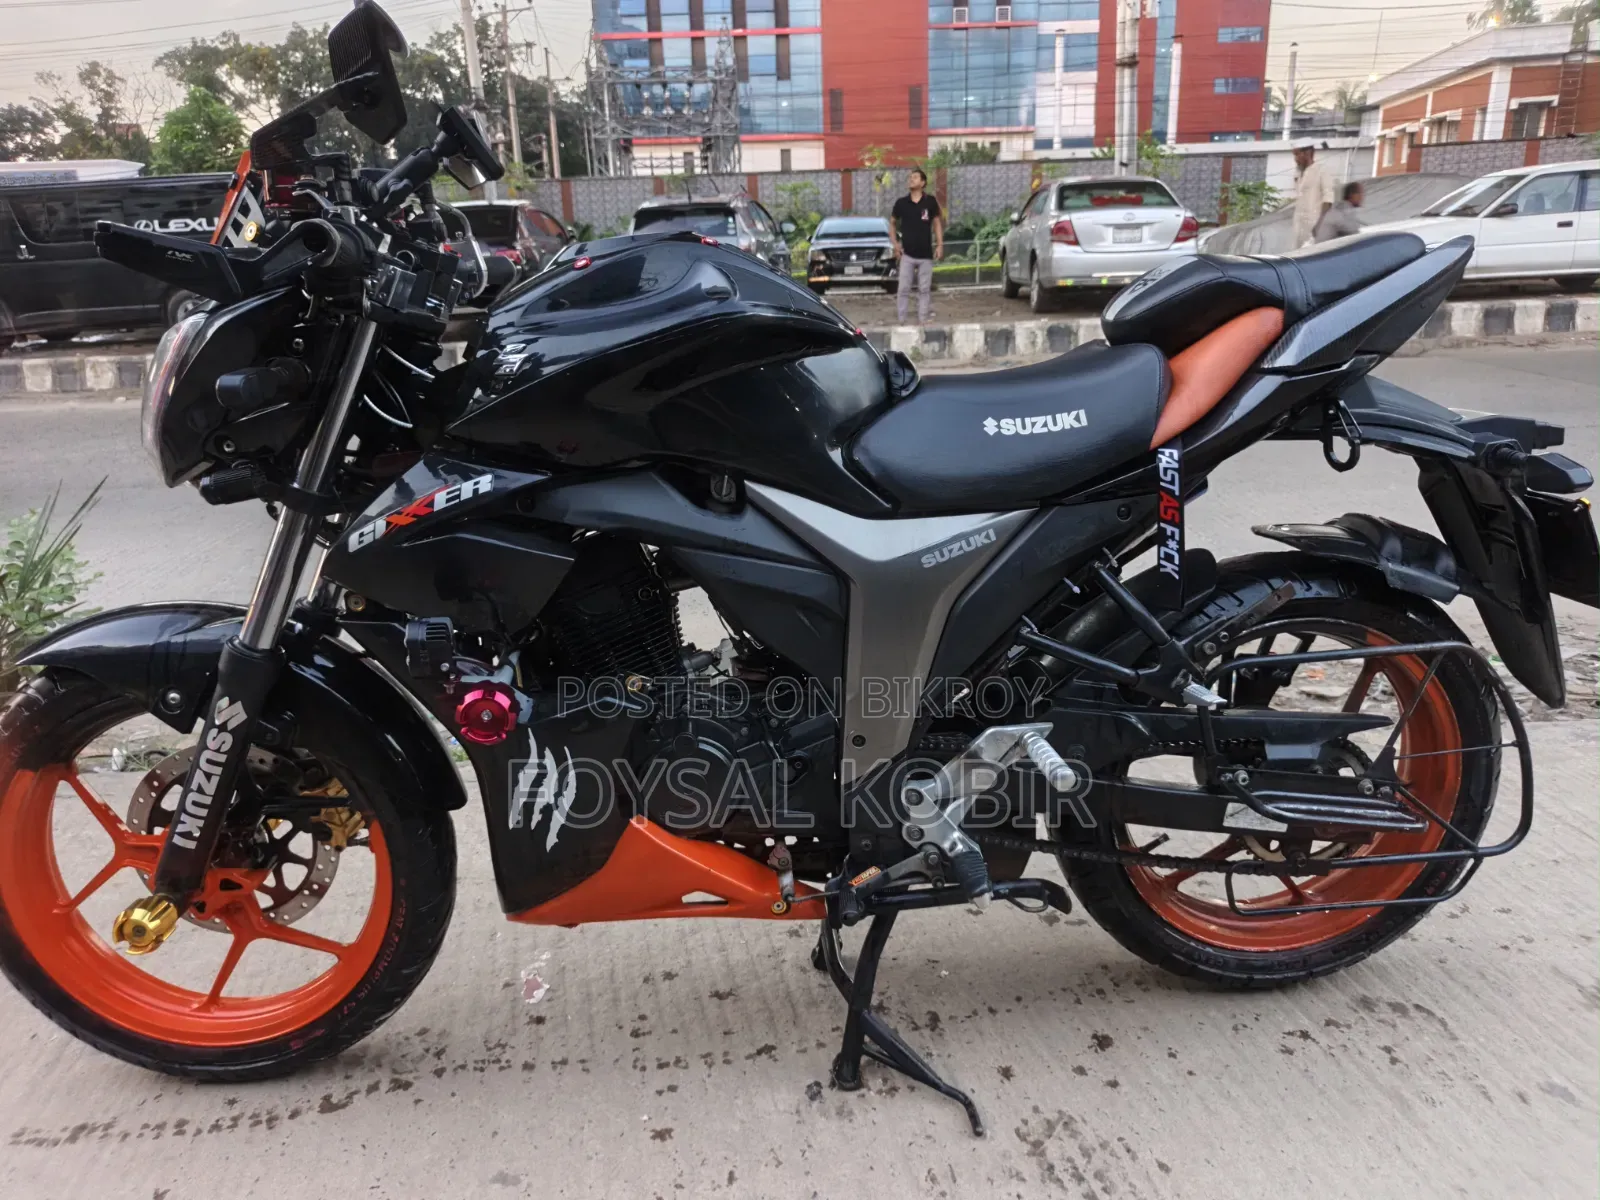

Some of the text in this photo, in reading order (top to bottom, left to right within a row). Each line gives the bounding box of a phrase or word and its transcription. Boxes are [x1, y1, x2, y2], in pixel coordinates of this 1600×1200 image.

[153, 217, 220, 232] LEXU
[999, 409, 1088, 435] SUZUKI
[1157, 448, 1180, 496] FAST
[348, 473, 494, 552] GIXXER
[1159, 490, 1180, 524] AS
[921, 528, 997, 568] SUZUKI
[172, 728, 233, 849] SUZUKI
